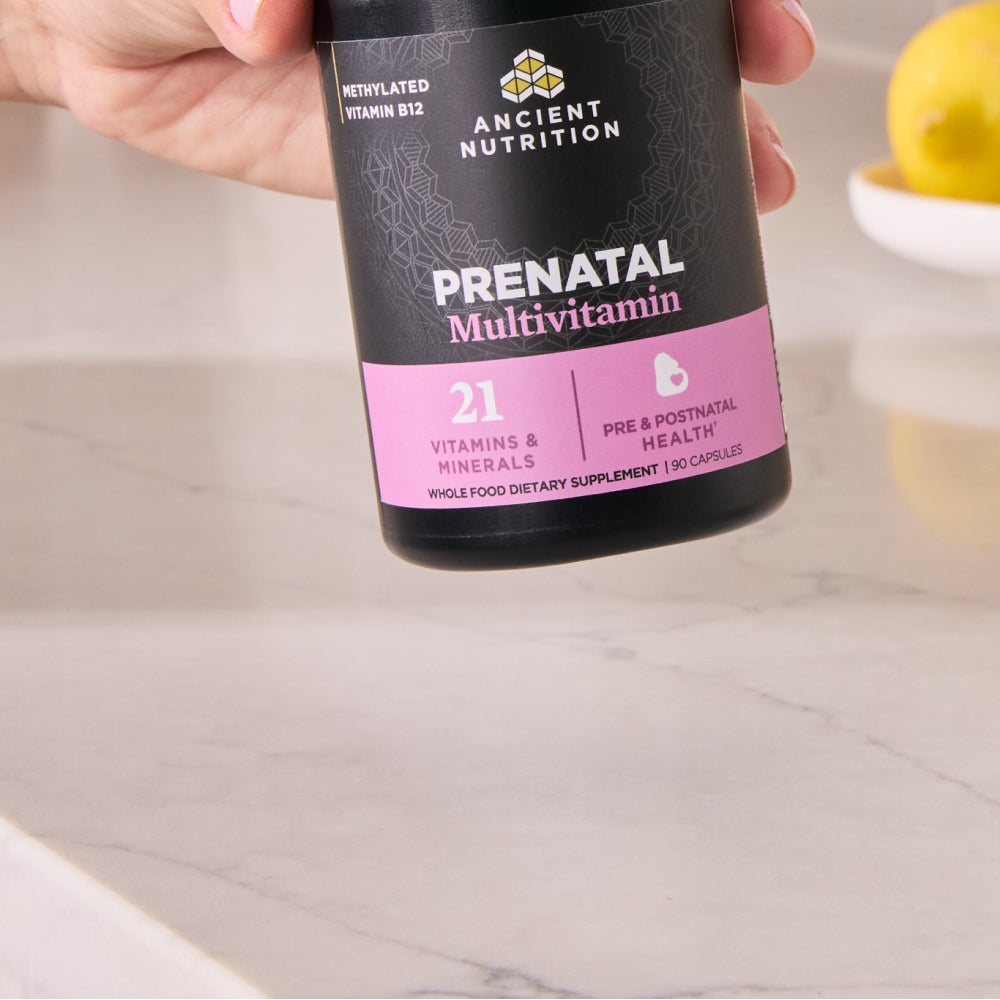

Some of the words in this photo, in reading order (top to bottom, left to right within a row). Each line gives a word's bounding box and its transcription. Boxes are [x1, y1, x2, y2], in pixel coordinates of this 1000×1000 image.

[342, 79, 430, 98] METHYLATED
[345, 104, 395, 120] VITAMIN
[398, 101, 424, 117] B12
[473, 100, 601, 133] ANCIENT
[460, 120, 621, 158] NUTRITION
[432, 239, 685, 306] PRENATAL
[446, 284, 683, 344] Multivitamin
[449, 379, 504, 424] 21
[603, 419, 637, 437] PRE
[640, 417, 652, 431] &
[655, 397, 738, 428] POSTNATAL
[430, 435, 519, 455] VITAMINS
[526, 433, 538, 448] &
[428, 487, 468, 499] WHOLE
[470, 485, 506, 498] FOOD
[509, 478, 567, 495] DIETARY
[571, 463, 659, 488] SUPPLEMENT
[689, 443, 743, 467] CAPSULES
[438, 454, 536, 475] MINERALS
